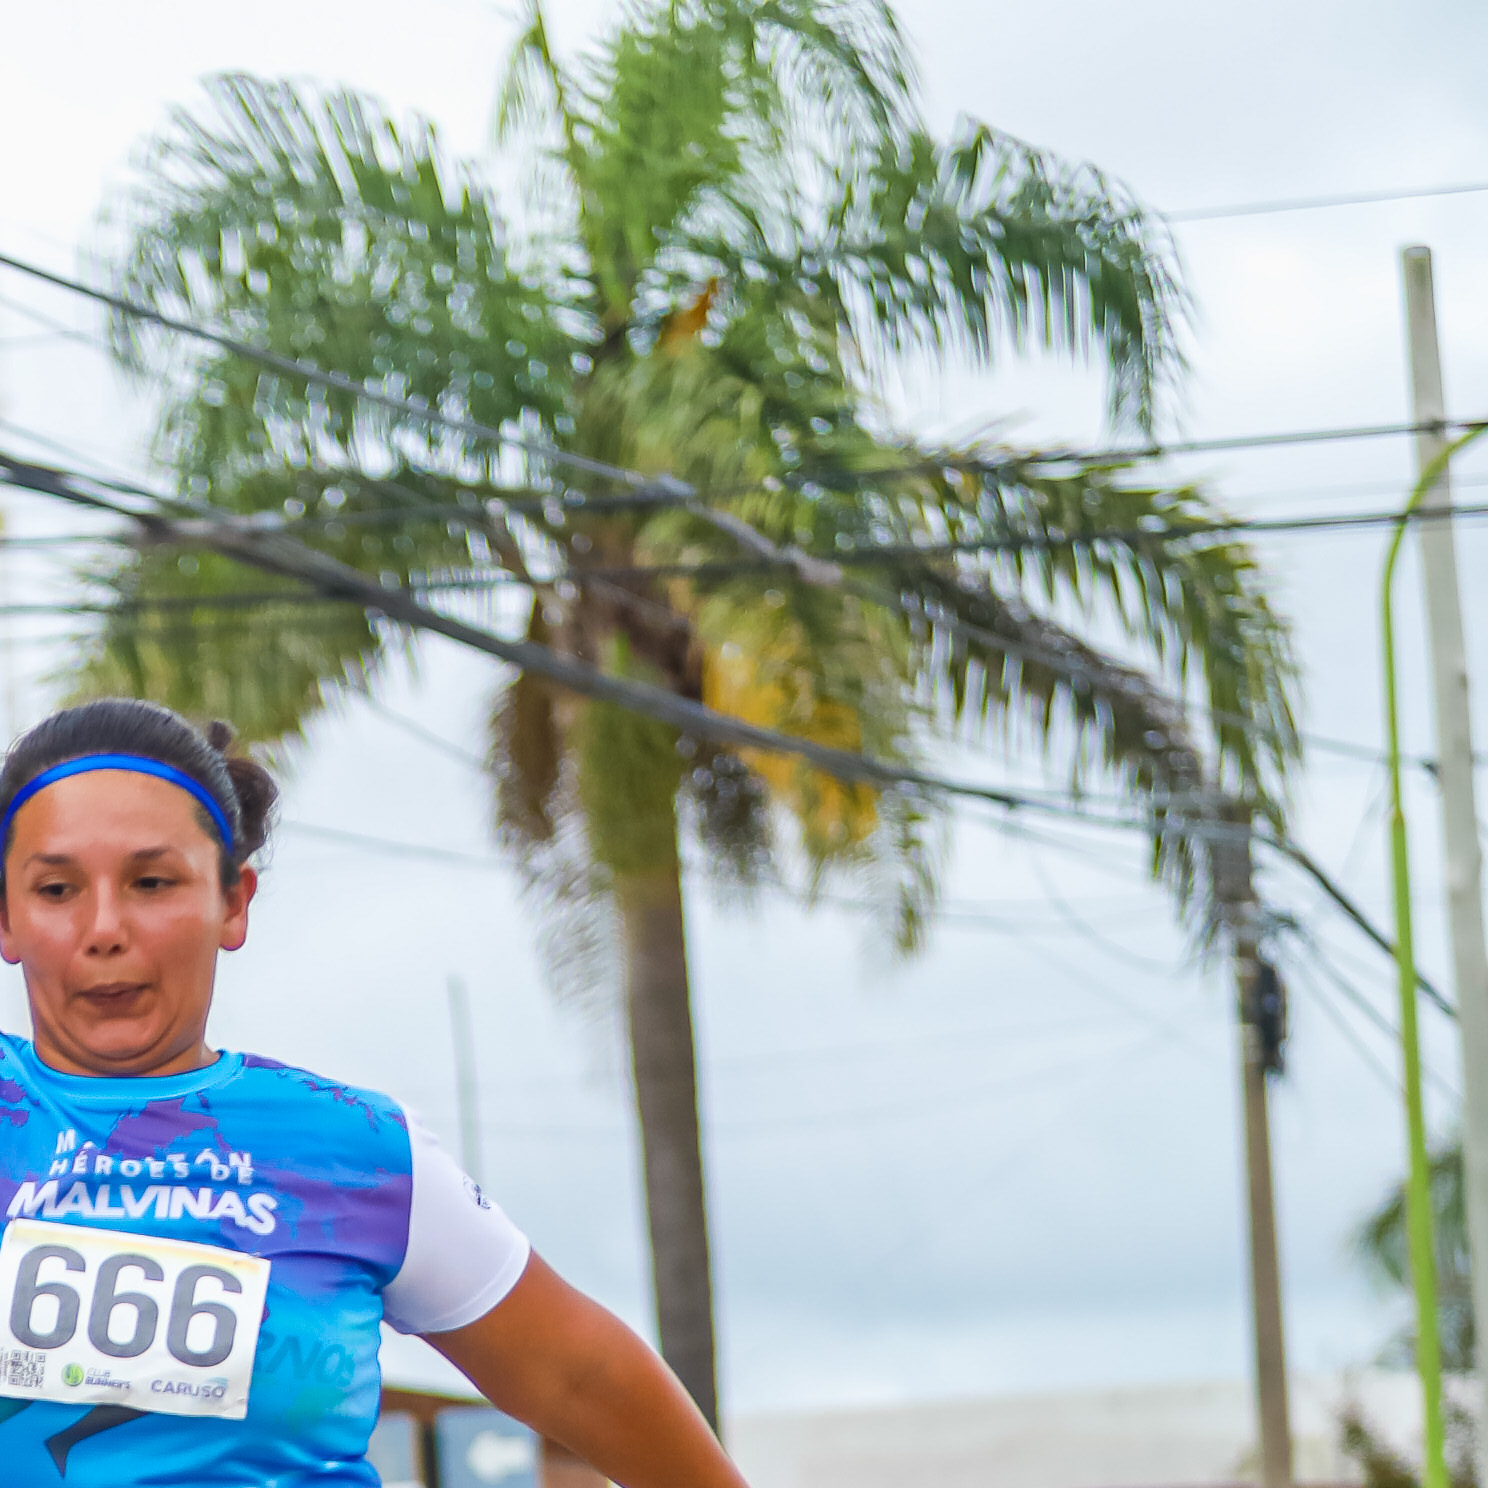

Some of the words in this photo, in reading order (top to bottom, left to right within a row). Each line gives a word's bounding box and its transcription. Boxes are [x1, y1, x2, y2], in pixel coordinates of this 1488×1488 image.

[49, 1151, 190, 1179] HÉROES
[210, 1162, 255, 1186] DE
[5, 1179, 279, 1236] MALVINAS
[9, 1243, 243, 1368] 666
[150, 1379, 228, 1399] CARUSO
